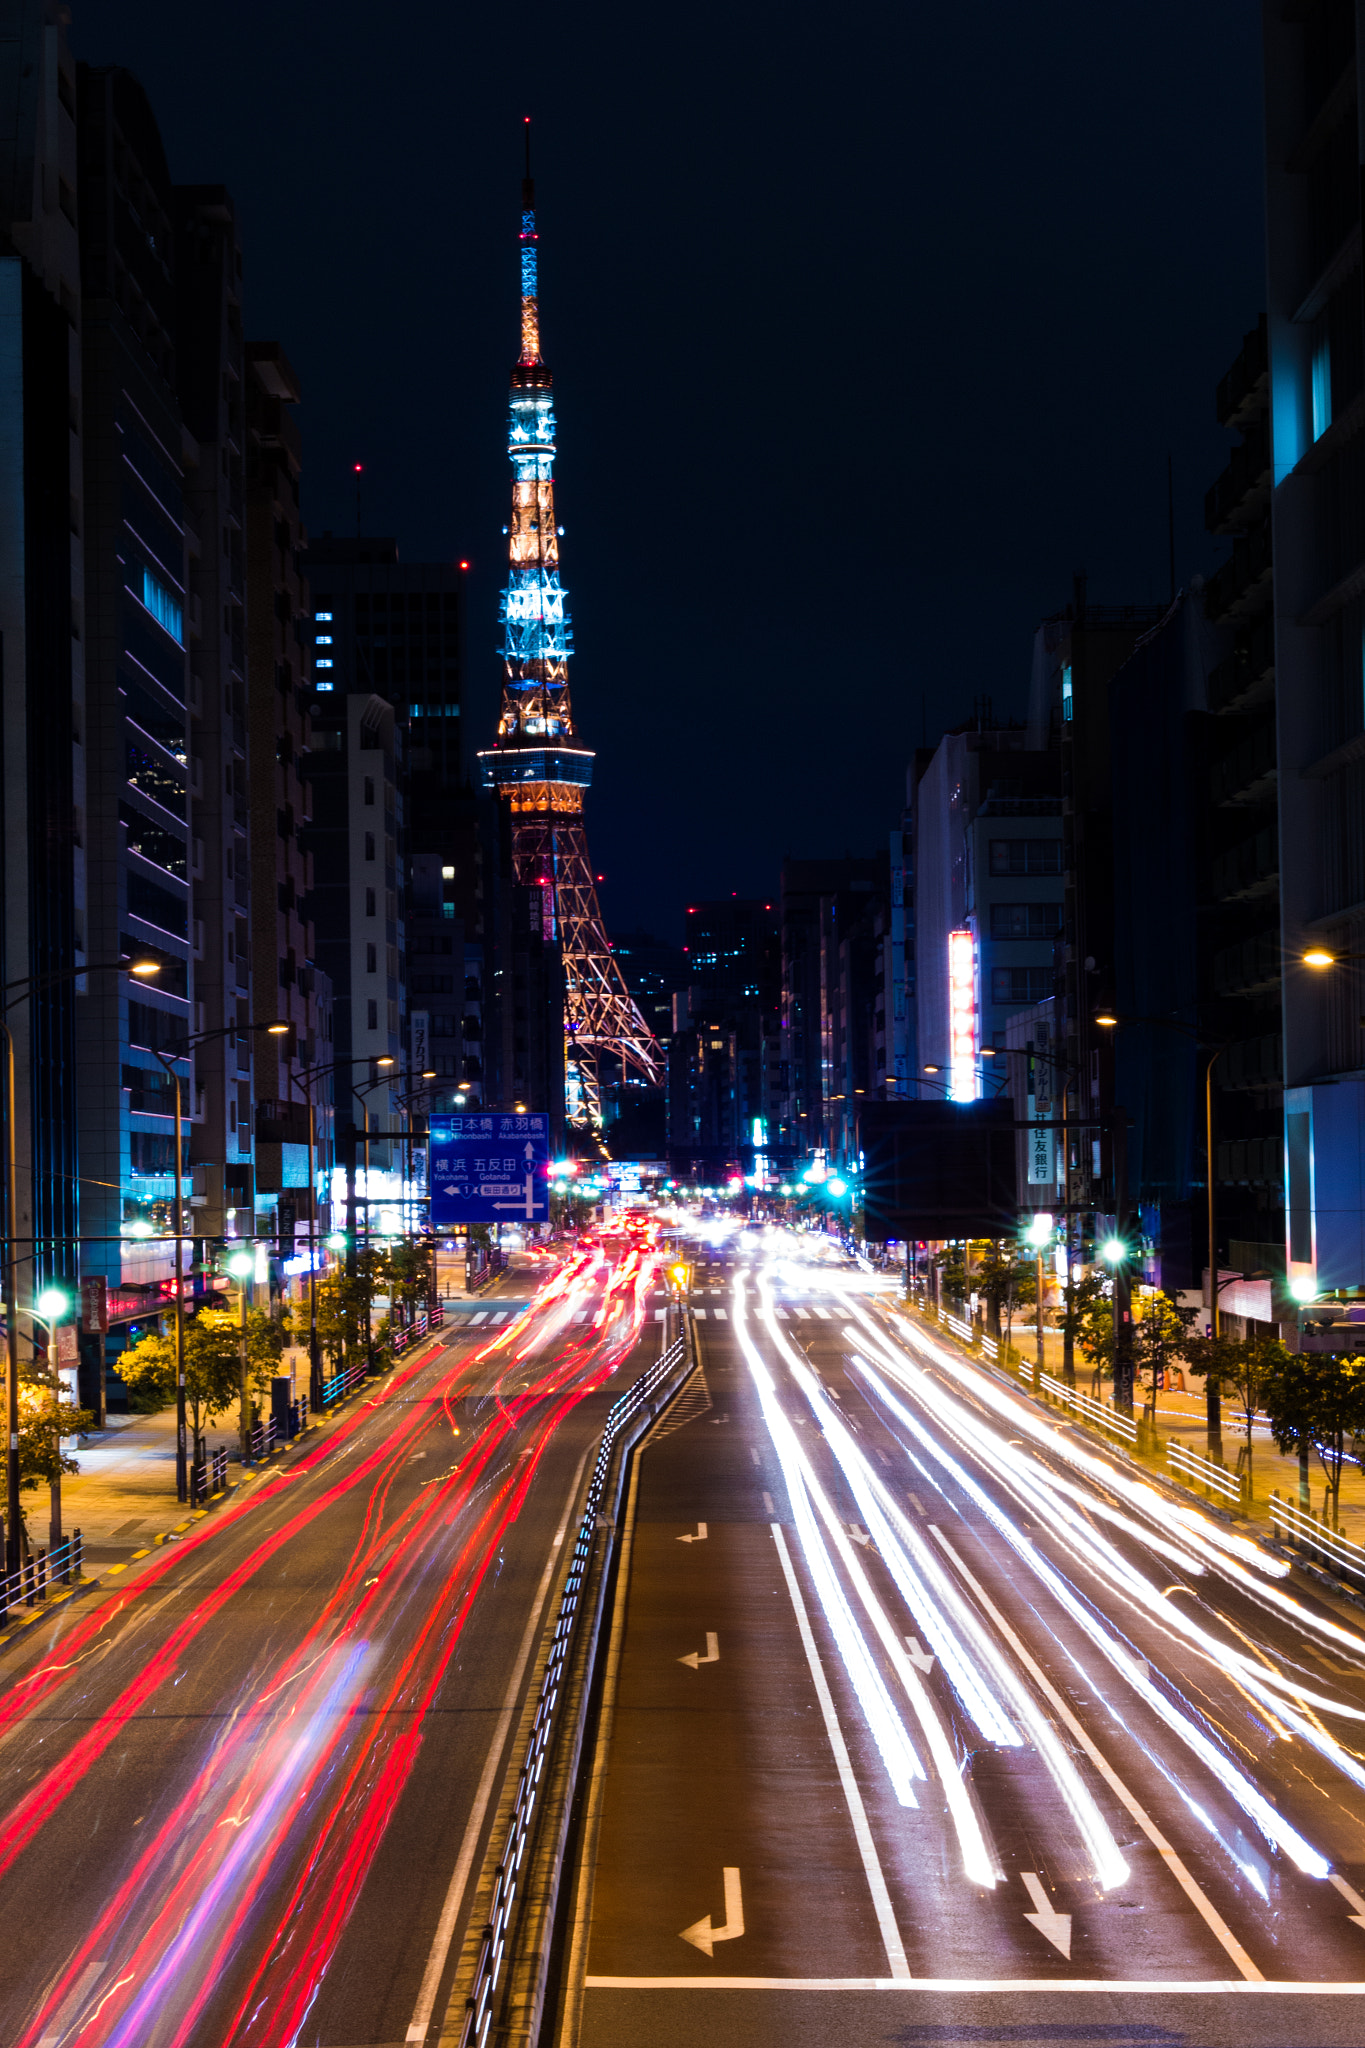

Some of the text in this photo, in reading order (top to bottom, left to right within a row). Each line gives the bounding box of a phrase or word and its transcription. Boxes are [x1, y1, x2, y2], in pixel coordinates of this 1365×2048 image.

[450, 1117, 544, 1131] 日本橋 赤羽橋
[451, 1132, 545, 1140] Nihonbashi Akabanebashi
[1034, 1113, 1048, 1179] 井住友銀行
[435, 1158, 467, 1172] 横浜
[473, 1158, 516, 1172] 五反田
[433, 1172, 511, 1181] Yokohama Gotanda
